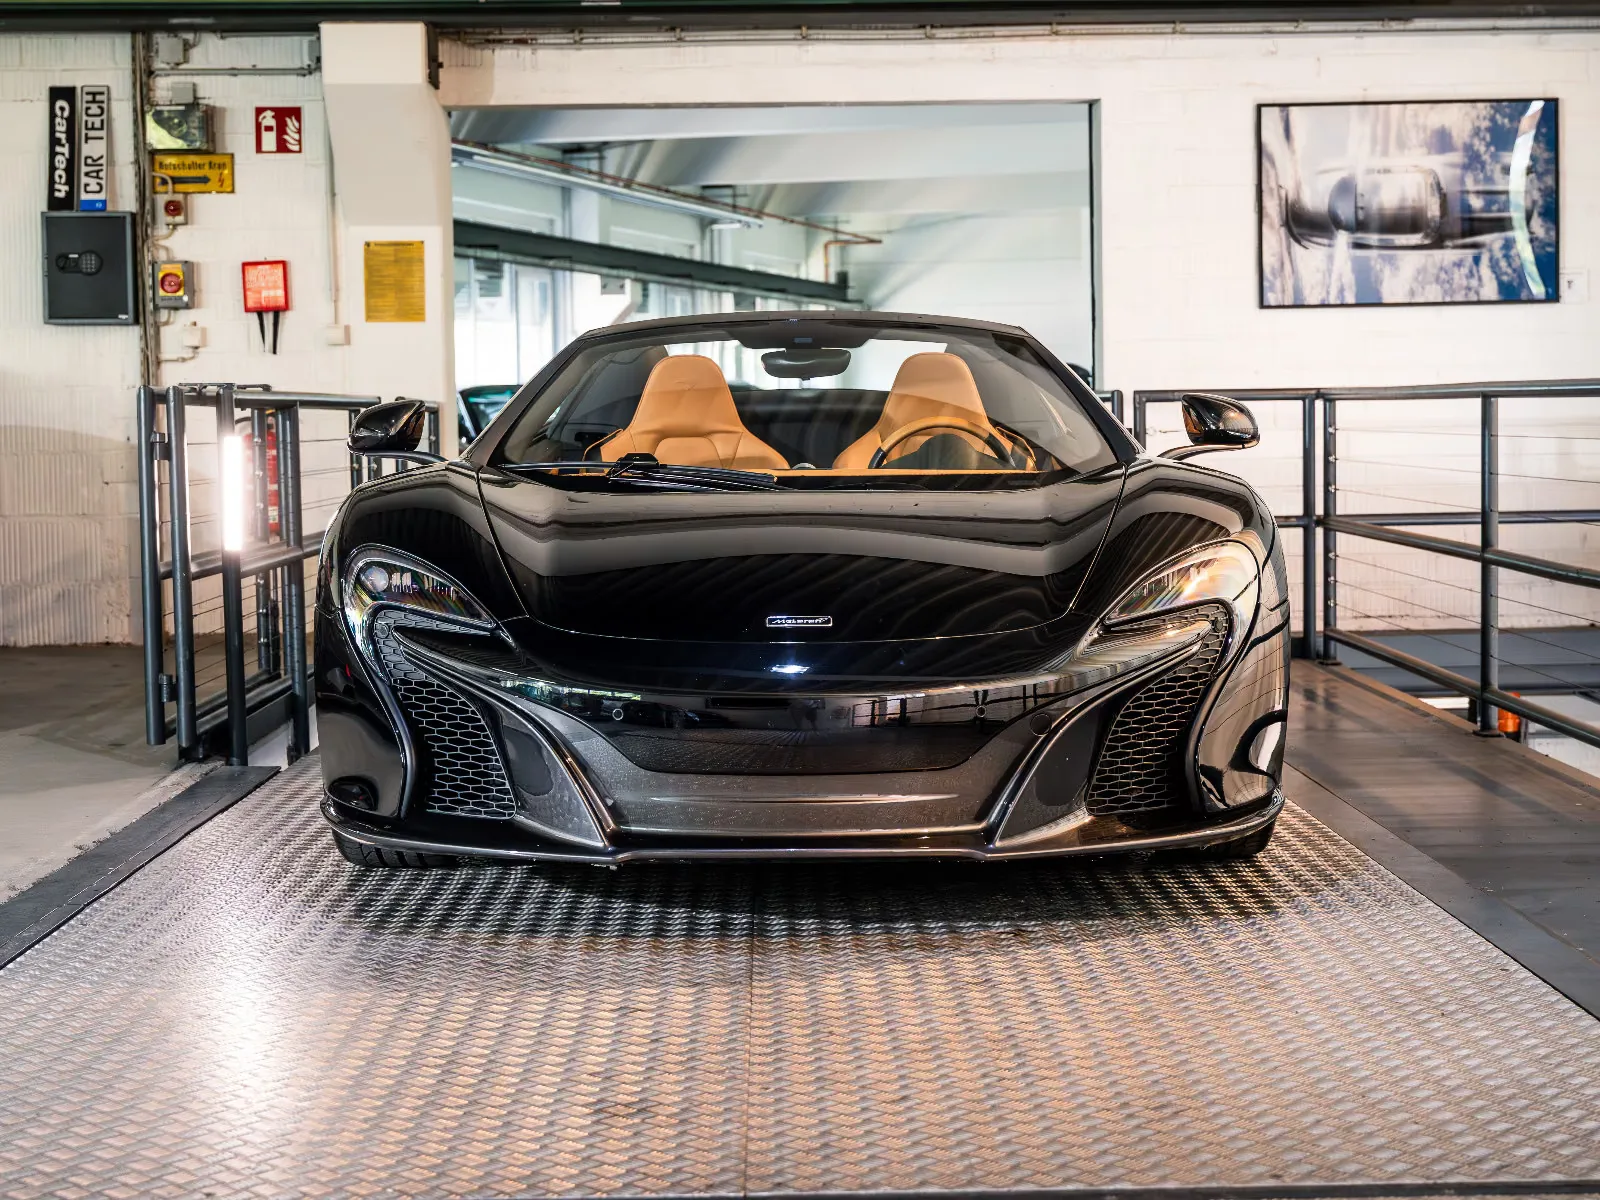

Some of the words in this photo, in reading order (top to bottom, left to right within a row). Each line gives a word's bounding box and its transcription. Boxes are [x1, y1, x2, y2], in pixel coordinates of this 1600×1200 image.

[84, 91, 105, 144] TECH
[54, 99, 70, 198] CarTech
[84, 155, 104, 194] CAR
